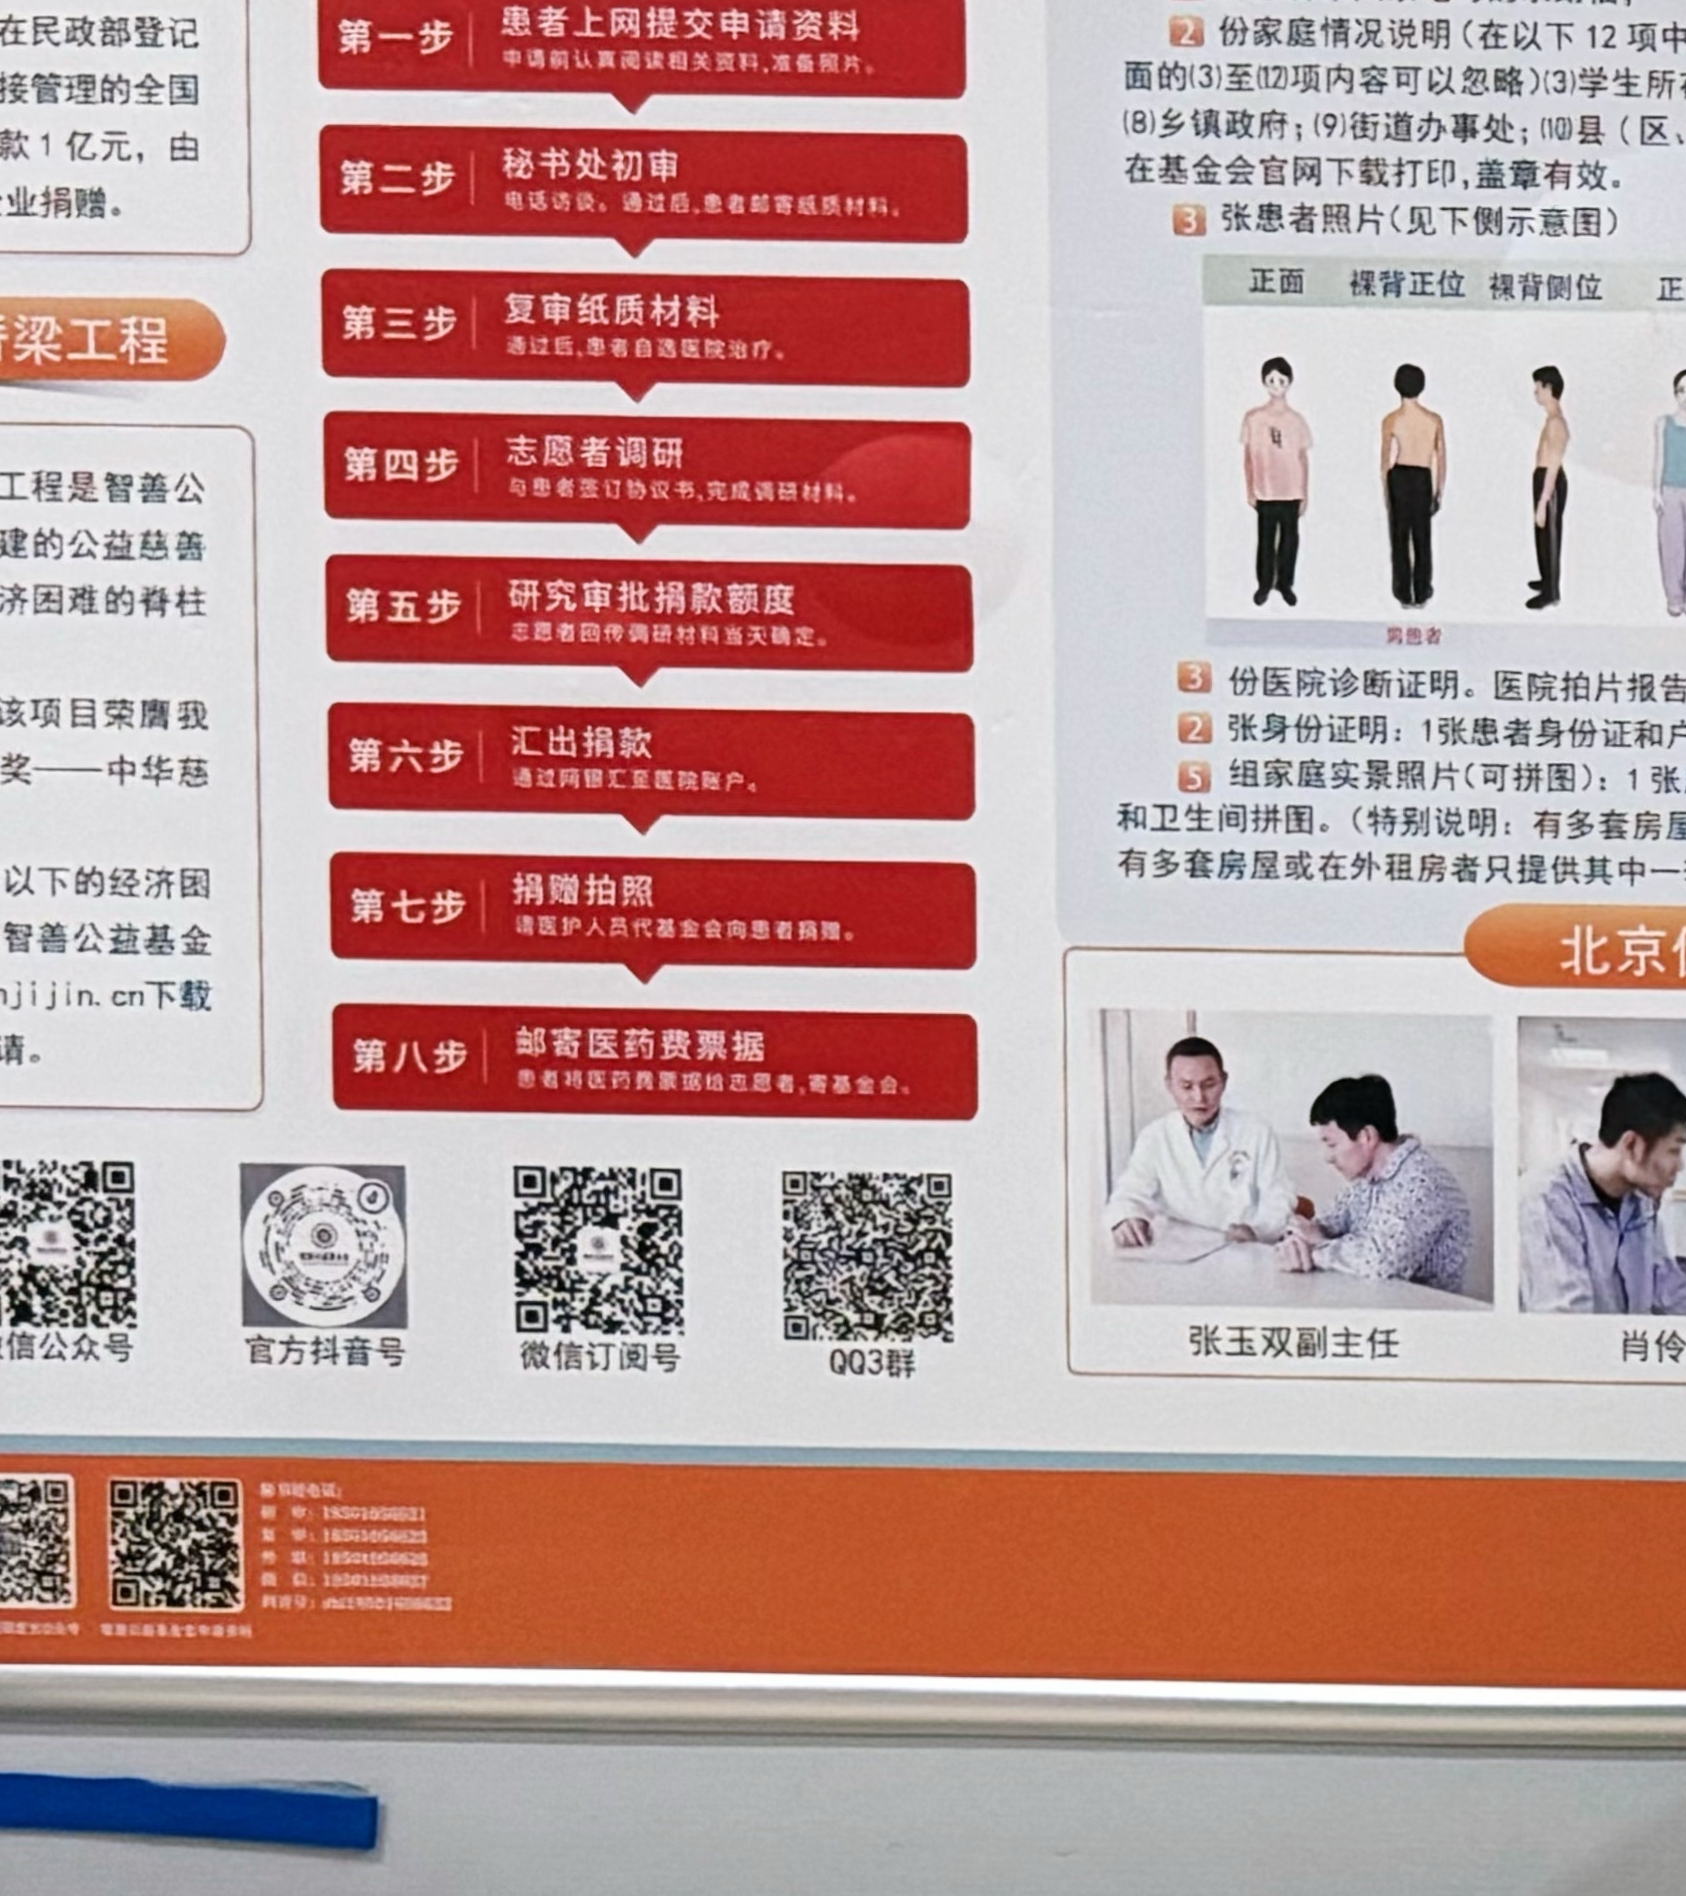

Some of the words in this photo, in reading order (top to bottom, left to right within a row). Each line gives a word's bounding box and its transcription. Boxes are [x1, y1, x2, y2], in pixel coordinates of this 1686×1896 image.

[0, 14, 200, 49] 在民政部登记
[338, 19, 454, 55] 第一步
[501, 6, 860, 42] 患者上网提交申请资料
[340, 159, 456, 196] 第二步
[502, 147, 679, 184] 秘书处初审
[0, 185, 122, 220] 业捐赠。
[1249, 267, 1305, 295] 正面
[1350, 269, 1466, 298] 裸背正位
[1490, 272, 1603, 302] 裸背侧位
[342, 304, 458, 341] 第三步
[504, 293, 720, 328] 复审纸质材料
[344, 446, 460, 483] 第四步
[506, 434, 684, 470] 志愿者调研
[0, 470, 206, 505] 工程是智善公
[0, 527, 207, 562] 建的公益慈善
[346, 586, 462, 624] 第五步
[508, 579, 796, 616] 研究审批捐款额度
[348, 737, 465, 774] 第六步
[511, 725, 653, 760] 汇出捐款
[4, 865, 211, 900] 以下的经济困
[512, 872, 654, 907] 捐赠拍照
[350, 888, 467, 925] 第七步
[4, 921, 213, 956] 智善公益基金
[352, 1038, 469, 1075] 第八步
[515, 1026, 766, 1062] 邮寄医药费票据
[0, 1331, 135, 1365] 信公众号
[245, 1335, 407, 1369] 官方抖音号
[520, 1340, 682, 1374] 微信订阅号
[1188, 1322, 1400, 1362] 张玉双副主任
[829, 1347, 916, 1379] QQ3群
